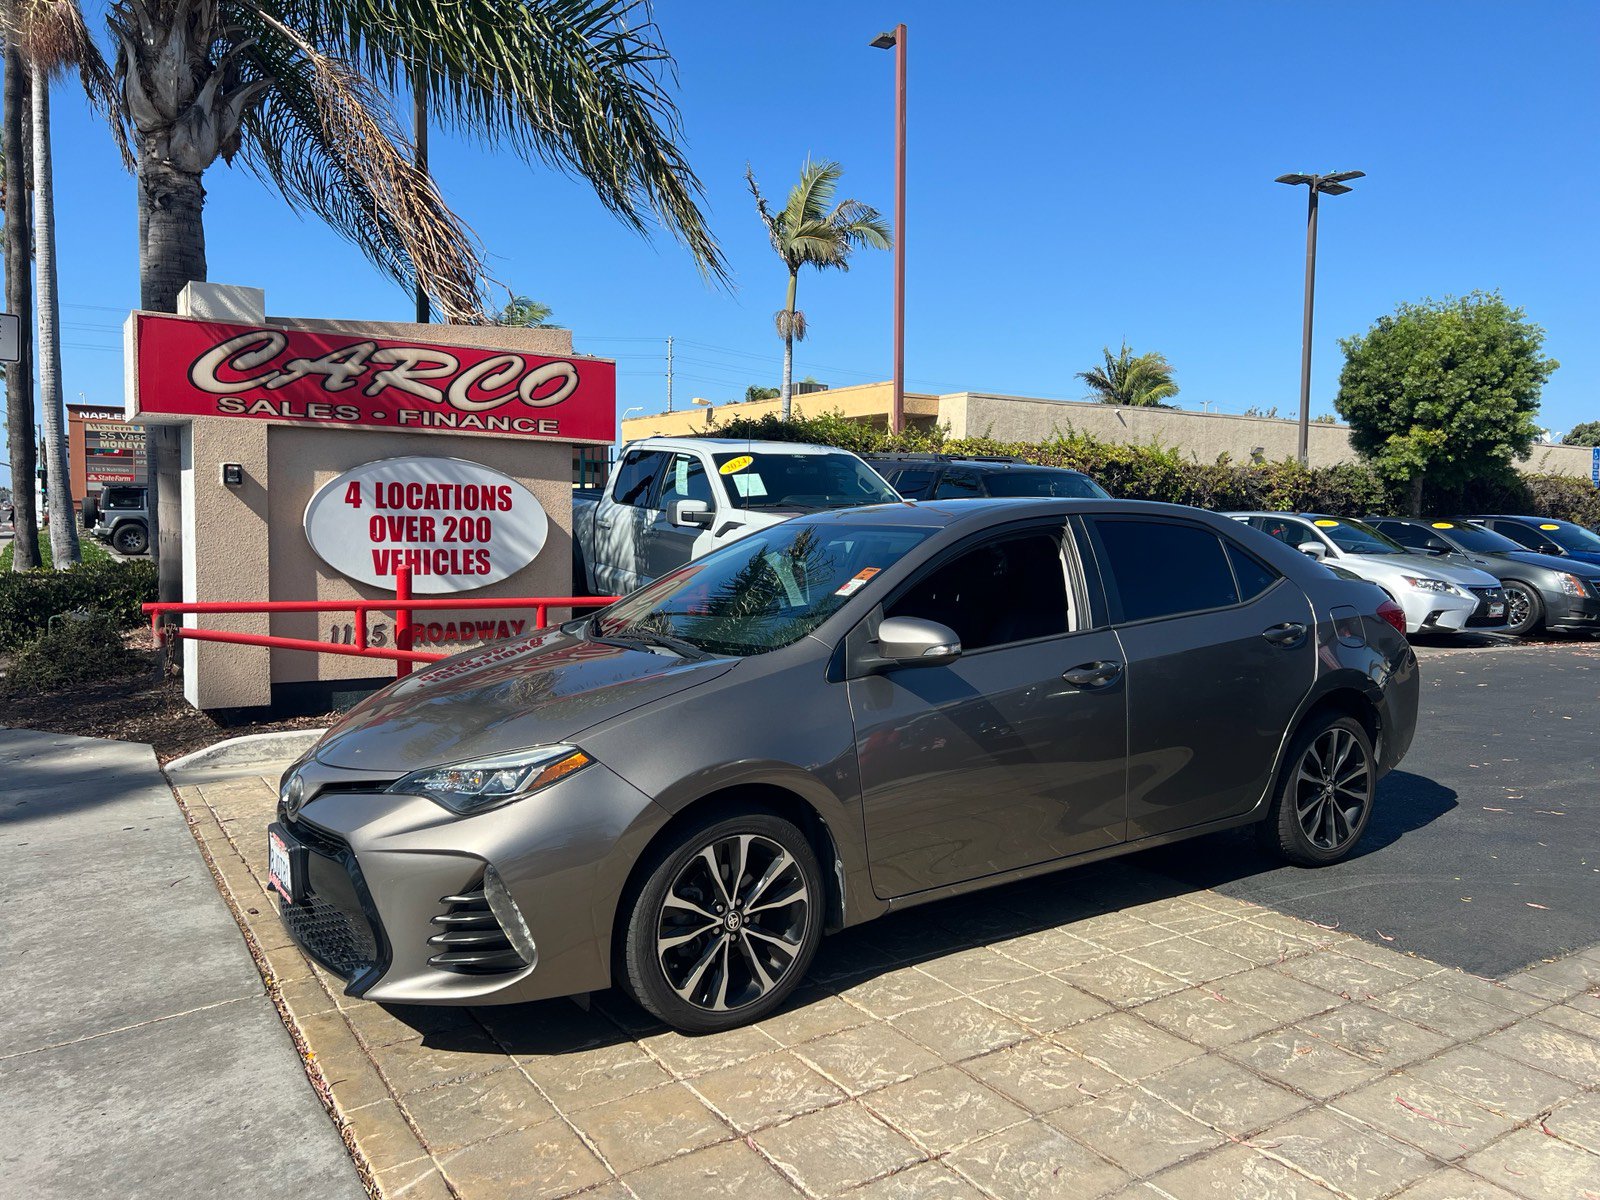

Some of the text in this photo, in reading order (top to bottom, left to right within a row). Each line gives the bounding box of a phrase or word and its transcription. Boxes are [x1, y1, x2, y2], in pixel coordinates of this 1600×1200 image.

[188, 330, 580, 412] CARCO
[217, 397, 559, 434] SALES FINANCE
[99, 432, 116, 440] SS
[345, 481, 513, 511] 4 LOCATIONS
[369, 515, 492, 543] OVER 200
[372, 549, 491, 576] VEHICLES
[331, 619, 526, 647] 115 ROADWAY
